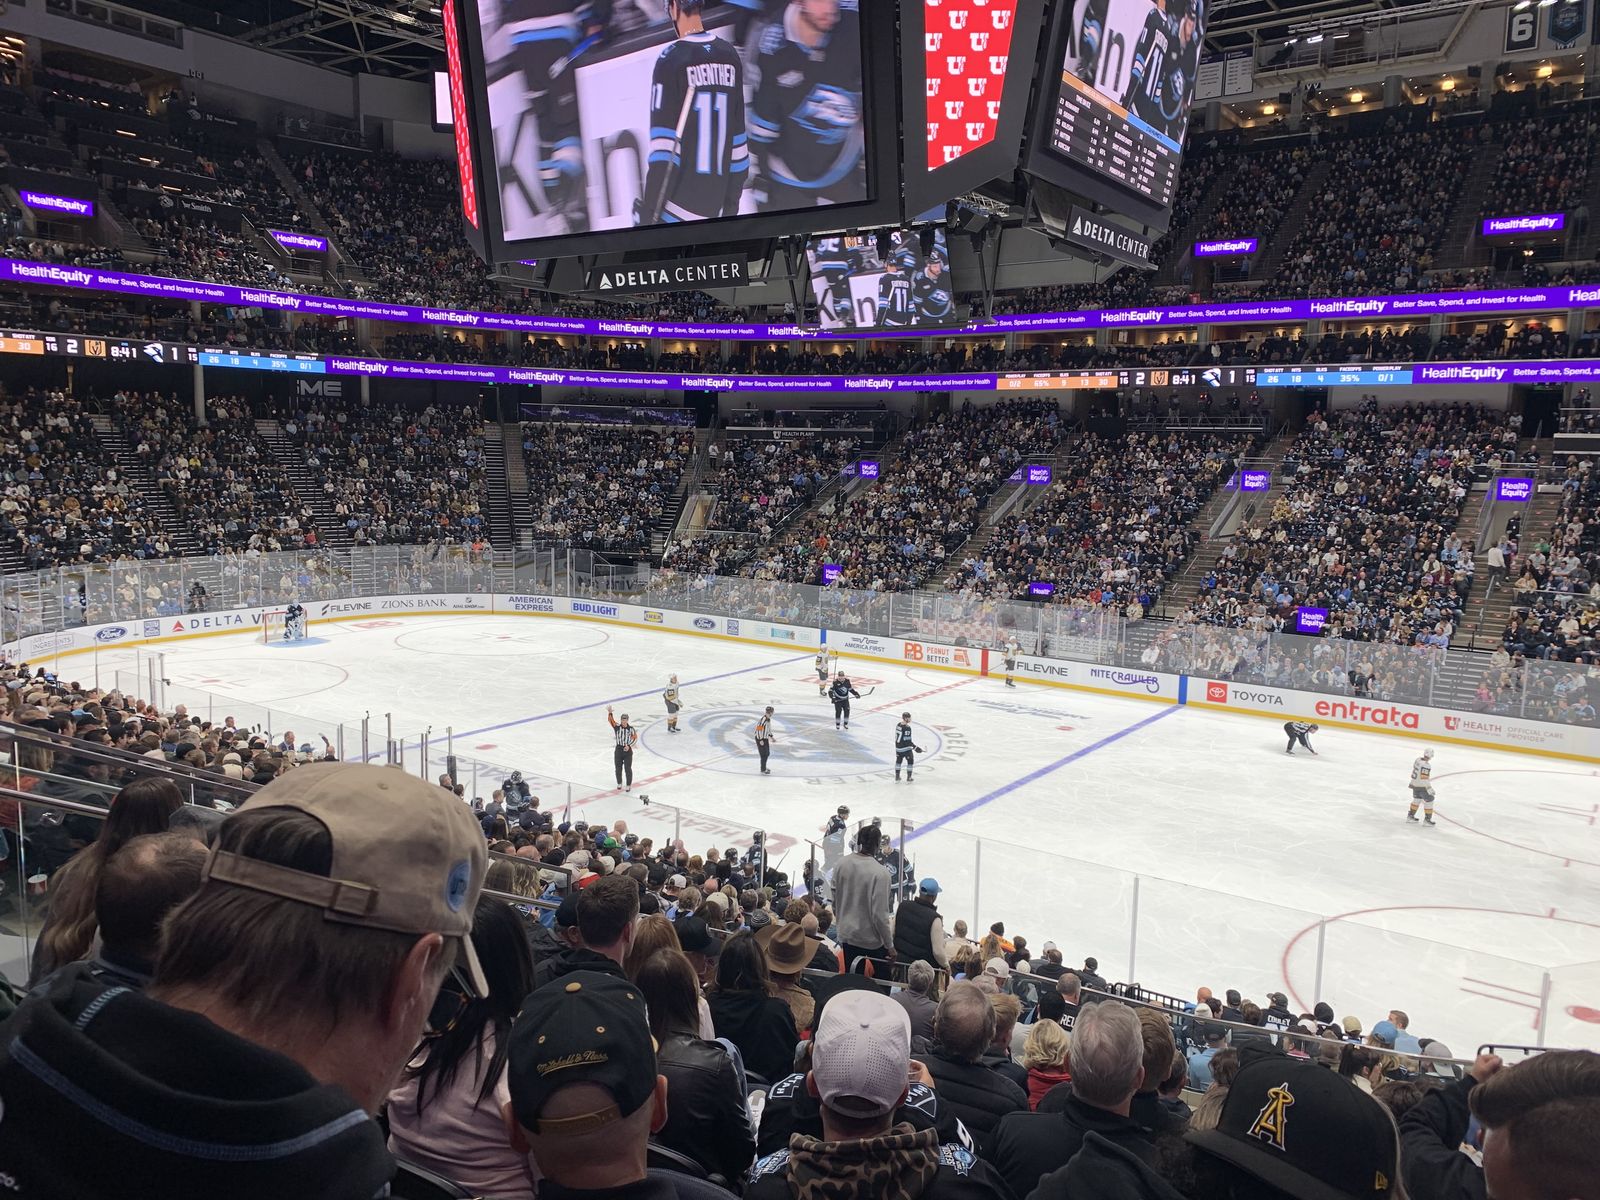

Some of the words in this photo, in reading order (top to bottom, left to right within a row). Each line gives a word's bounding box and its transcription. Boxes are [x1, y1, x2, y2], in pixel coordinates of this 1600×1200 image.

[1512, 12, 1533, 42] 6
[686, 63, 735, 87] GUENTHER
[693, 92, 728, 175] 11
[27, 194, 86, 213] HealthEquity
[1490, 217, 1557, 230] HealthEquity
[276, 234, 322, 249] HealthEquity
[1083, 222, 1114, 247] DELTA
[1116, 233, 1149, 257] CENTER
[1200, 241, 1252, 252] HealthEquity
[12, 262, 92, 285] HealthEquity
[98, 276, 120, 284] Better
[120, 278, 140, 287] Save,
[140, 281, 162, 290] Spend,
[176, 285, 195, 293] Invest
[615, 269, 669, 287] DELTA
[675, 263, 740, 282] CENTER
[240, 291, 300, 308] HealthEquity
[322, 302, 338, 310] Save,
[338, 304, 357, 312] Spend,
[1310, 300, 1386, 313] HealthEquity
[1438, 298, 1465, 307] Spend,
[1468, 297, 1481, 305] and
[1519, 294, 1546, 302] Health
[422, 310, 478, 325] HealthEquity
[1100, 310, 1162, 323] HealthEquity
[598, 322, 654, 335] HealthEquity
[46, 343, 58, 351] 16
[67, 339, 78, 353] 2
[111, 346, 137, 358] 8:41
[171, 347, 178, 360] 1
[188, 353, 198, 361] 15
[332, 360, 388, 374] HealthEquity
[1422, 366, 1506, 380] HealthEquity
[1512, 368, 1538, 376] Better
[1539, 368, 1562, 376] Save,
[1564, 367, 1591, 376] Spend,
[508, 370, 565, 384] HealthEquity
[1135, 372, 1145, 385] 2
[1172, 374, 1196, 385] 8:41
[1229, 370, 1235, 383] 1
[1246, 375, 1255, 383] 15
[681, 378, 734, 389] HealthEquity
[844, 379, 894, 389] HealthEquity
[1501, 482, 1529, 490] Health
[1501, 489, 1529, 498] Equity
[381, 599, 414, 609] ZIONS
[417, 598, 447, 608] BANK
[508, 596, 553, 605] AMERICAN
[330, 602, 372, 613] FILEVINE
[515, 603, 554, 612] EXPRESS
[573, 602, 591, 612] BUD
[592, 605, 618, 616] LIGHT
[190, 614, 243, 629] DELTA
[1301, 612, 1324, 620] Health
[1301, 619, 1325, 628] Equity
[99, 627, 127, 640] Ford
[844, 642, 869, 652] AMERICA
[868, 645, 885, 653] FIRST
[926, 646, 949, 656] PEANUT
[926, 654, 949, 664] BETTER
[1016, 661, 1069, 677] FILEVINE
[1090, 668, 1159, 689] NITECRAWLER
[1232, 690, 1284, 706] TOYOTA
[1315, 701, 1419, 729] entrata
[1463, 720, 1502, 734] HEALTH
[1507, 726, 1542, 737] OFFICIAL
[1543, 730, 1565, 740] CARE
[1507, 733, 1545, 743] PROVIDER
[1247, 1082, 1295, 1151] A
